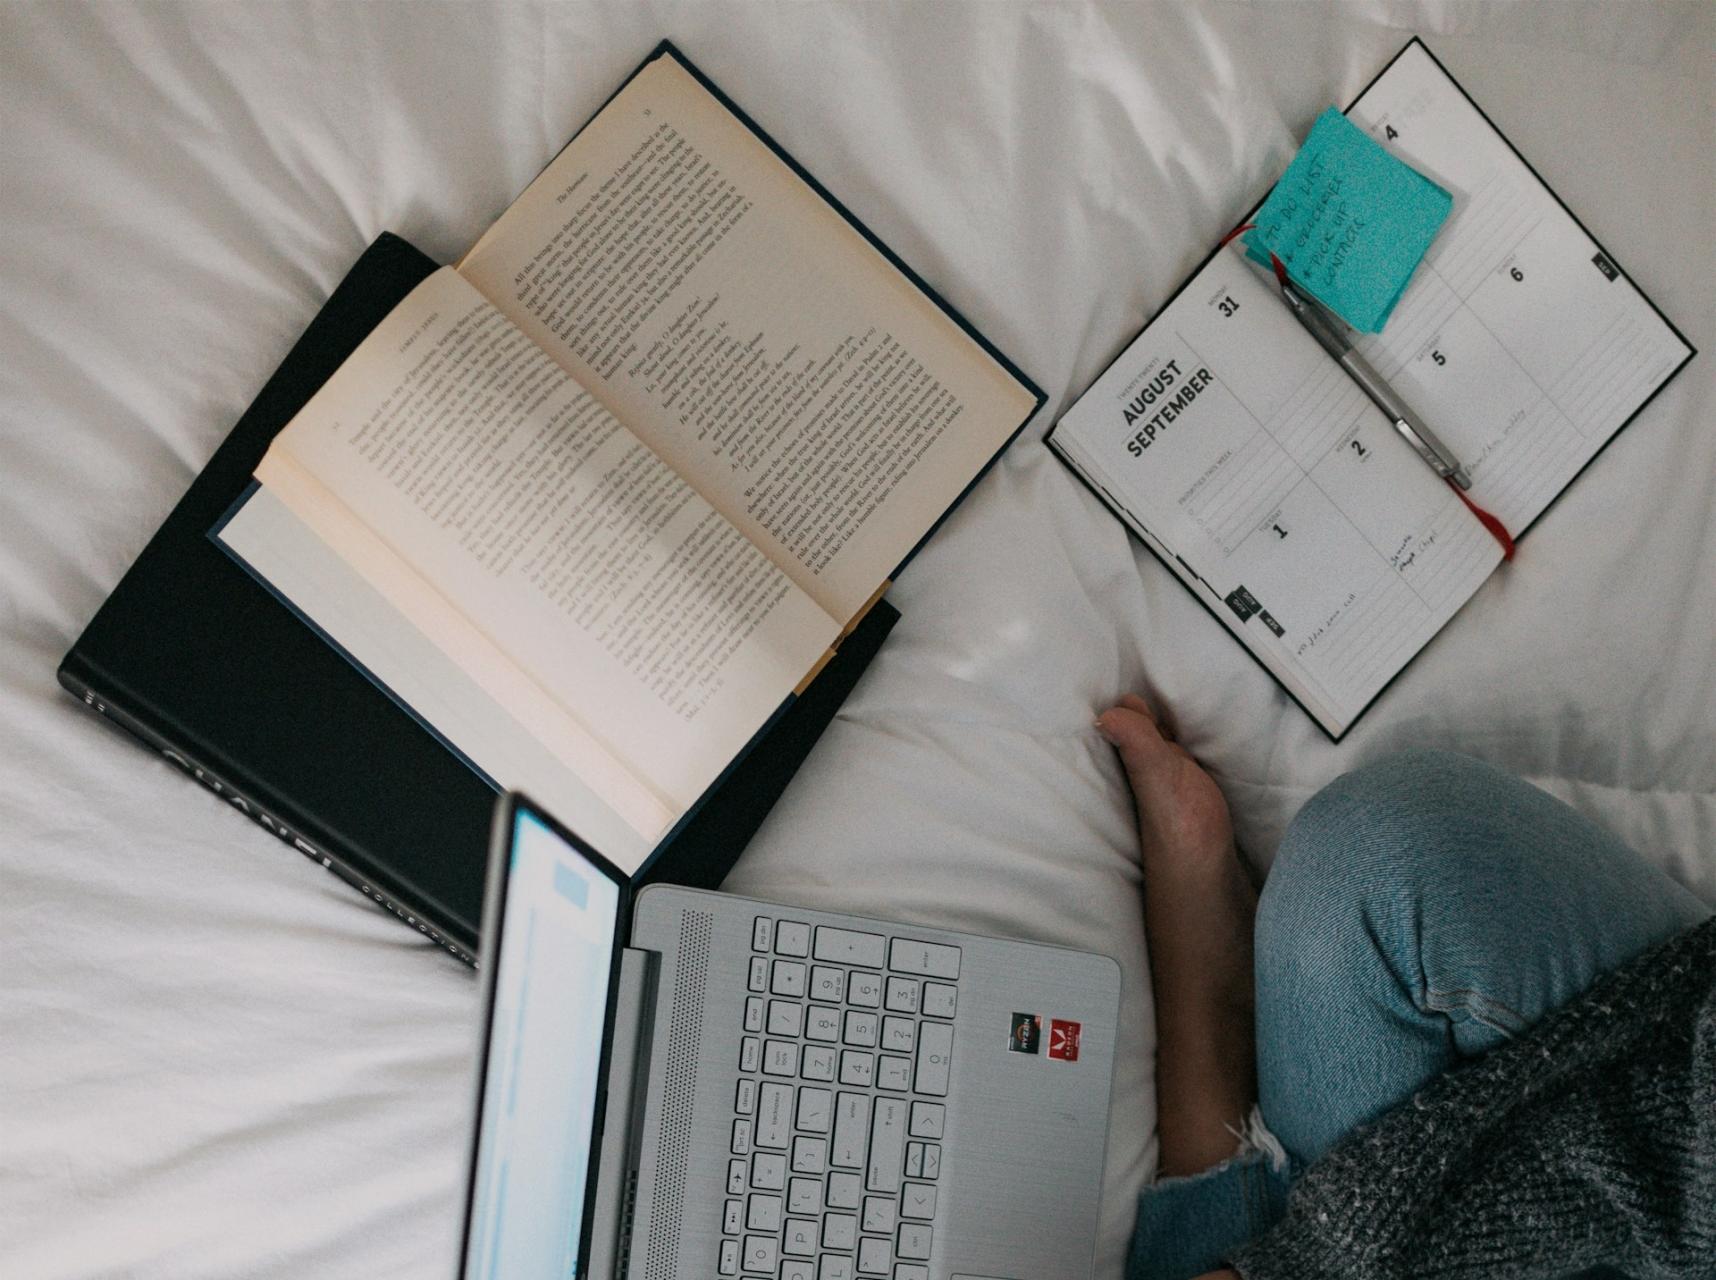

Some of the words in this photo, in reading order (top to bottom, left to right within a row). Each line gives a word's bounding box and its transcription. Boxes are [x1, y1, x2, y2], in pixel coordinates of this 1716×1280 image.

[1385, 124, 1399, 141] 4
[1277, 195, 1301, 221] DO
[1296, 151, 1328, 196] LIST
[1307, 229, 1338, 268] PICK
[1328, 198, 1354, 228] UP
[1510, 267, 1524, 282] 6
[1597, 260, 1611, 275] SEP
[1218, 296, 1240, 318] 31
[1431, 350, 1446, 366] 5
[1118, 357, 1185, 428] AUGUST
[1124, 365, 1215, 459] SEPTEMBER
[1351, 440, 1366, 456] 2
[1272, 524, 1288, 539] 1
[920, 950, 930, 967] enter
[822, 980, 833, 989] 9
[860, 985, 871, 994] 6
[897, 991, 908, 999] 3
[750, 1007, 759, 1021] end
[818, 1019, 829, 1028] 8
[856, 1024, 866, 1033] 5
[893, 1030, 904, 1038] 2
[745, 1045, 755, 1064] home
[852, 1064, 862, 1073] 4
[740, 1086, 750, 1107] delete
[769, 1090, 782, 1125] backspace
[848, 1100, 858, 1118] enter
[886, 1105, 894, 1119] shift
[795, 1232, 806, 1243] P
[830, 1269, 842, 1277] L
